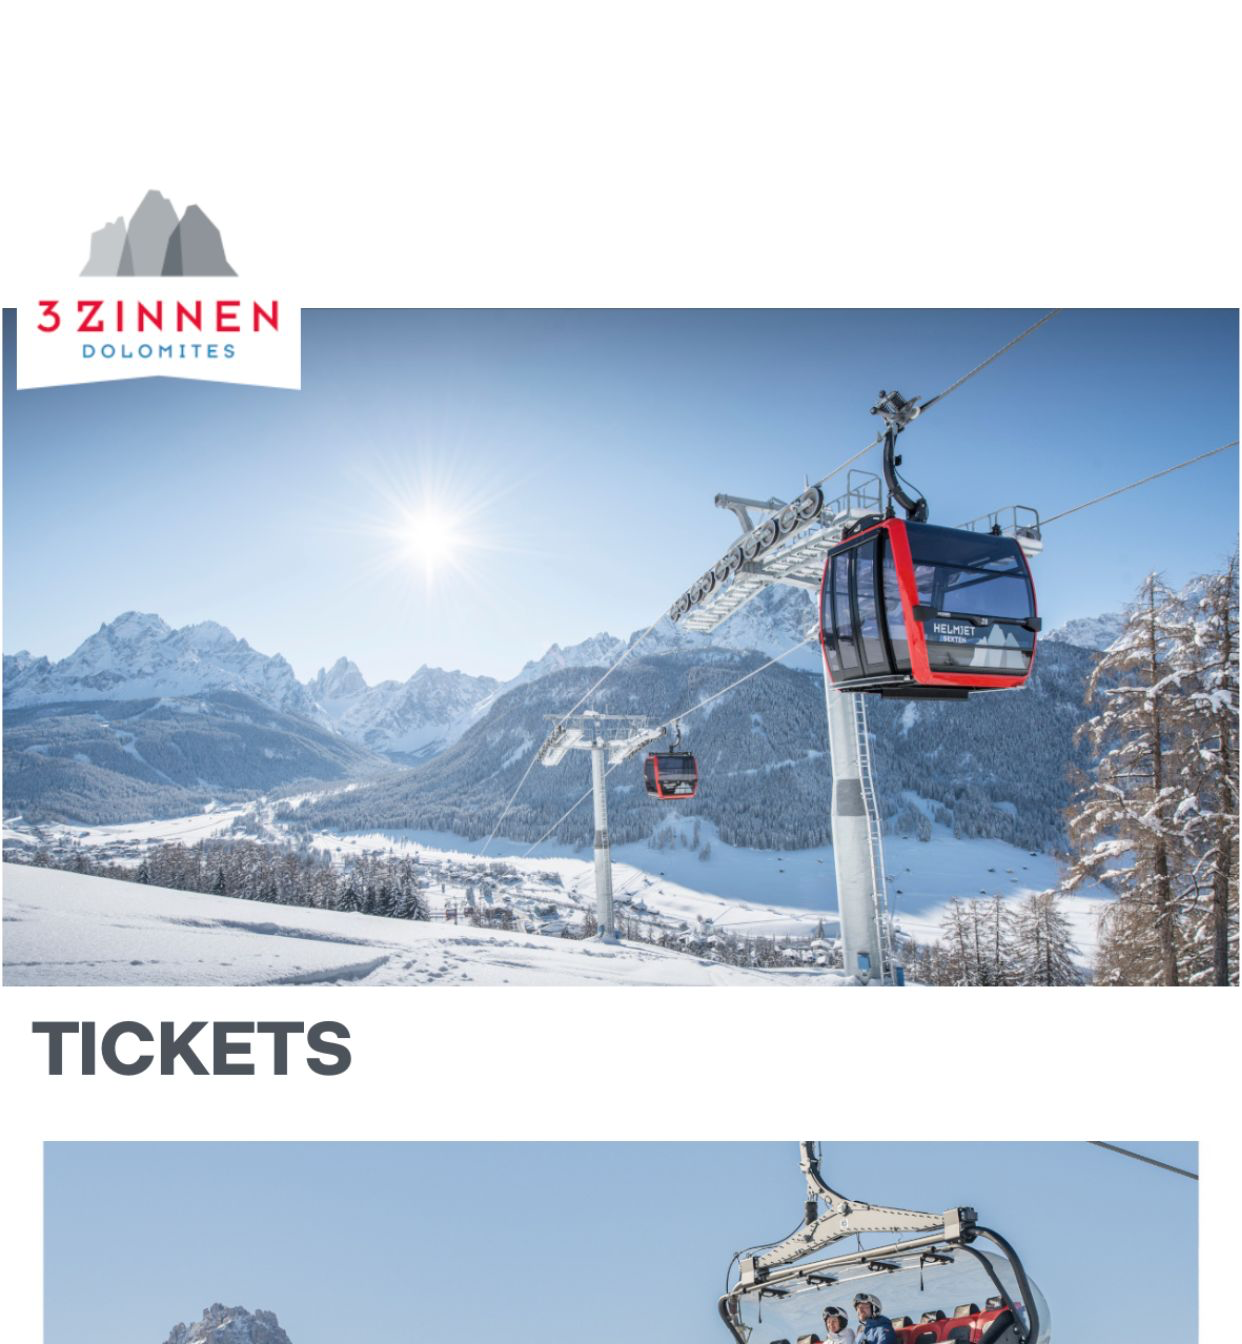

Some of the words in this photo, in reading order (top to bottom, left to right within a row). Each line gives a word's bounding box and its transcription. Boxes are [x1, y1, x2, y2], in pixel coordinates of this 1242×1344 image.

[37, 299, 61, 333] 3
[77, 299, 279, 333] ZINNEN
[82, 343, 236, 360] DOLOMITES
[933, 623, 976, 636] HELMJET
[32, 1020, 352, 1077] TICKETS
